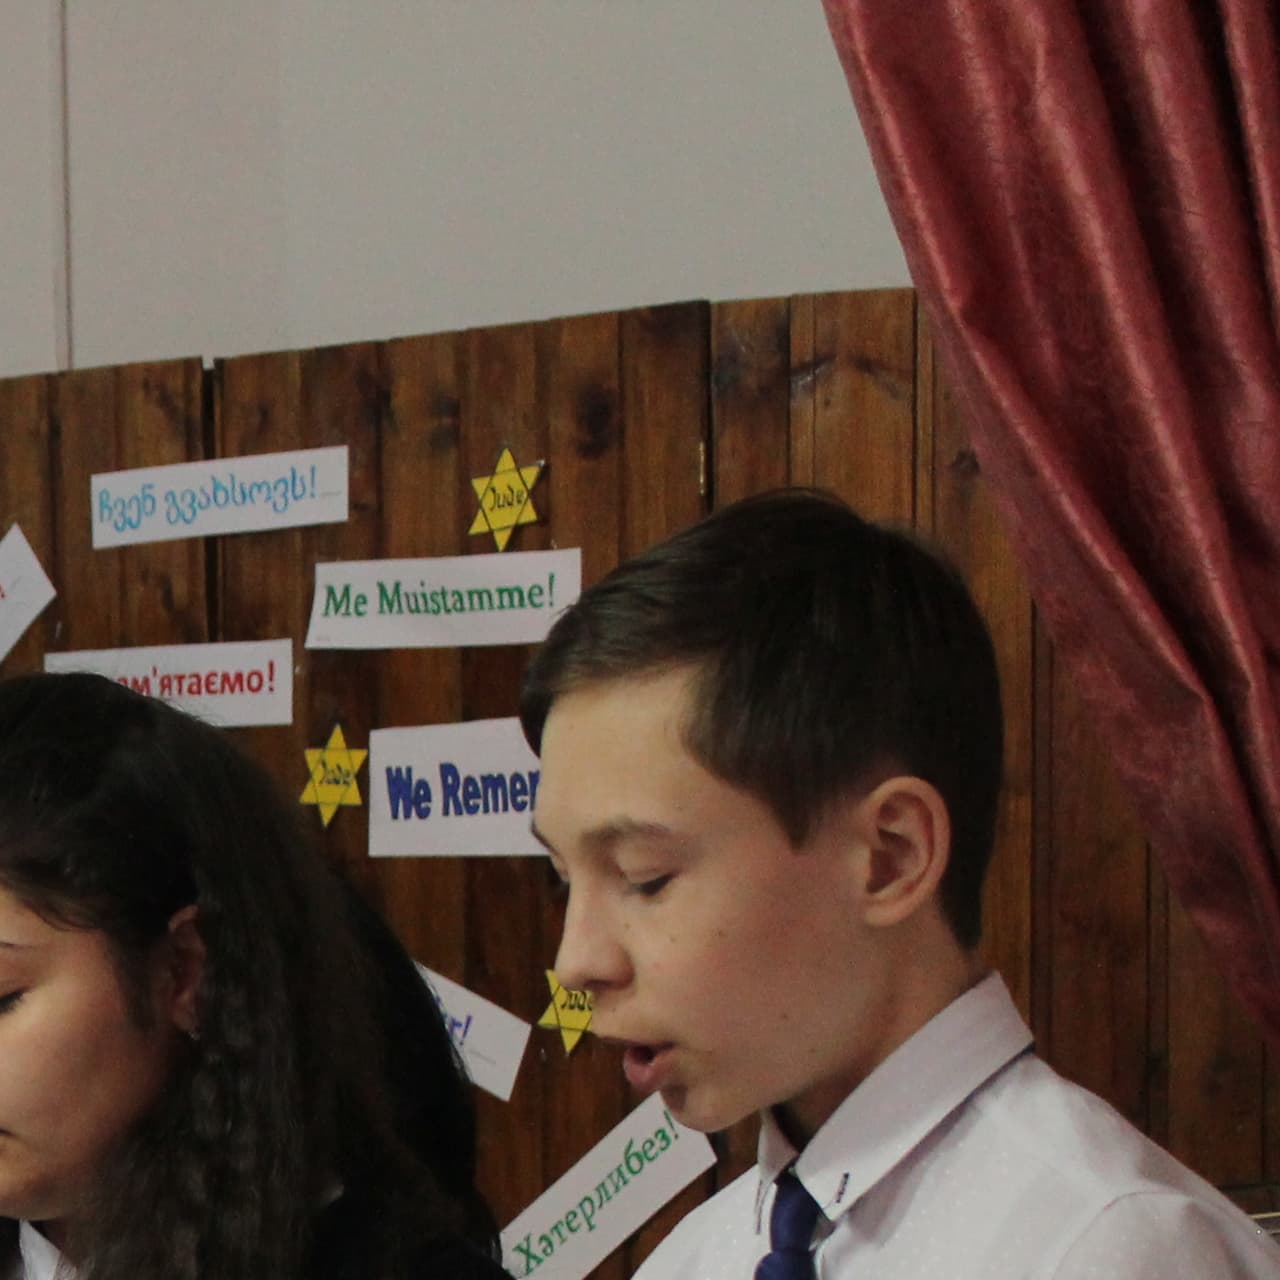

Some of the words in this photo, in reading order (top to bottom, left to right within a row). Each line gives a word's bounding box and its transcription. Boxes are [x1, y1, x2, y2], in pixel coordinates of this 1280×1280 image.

[323, 584, 368, 618] Me
[377, 572, 556, 616] Muistamme!
[118, 660, 276, 697] м'ятаємо!
[386, 765, 431, 820] We
[512, 1109, 680, 1276] Хәтерлибез!
